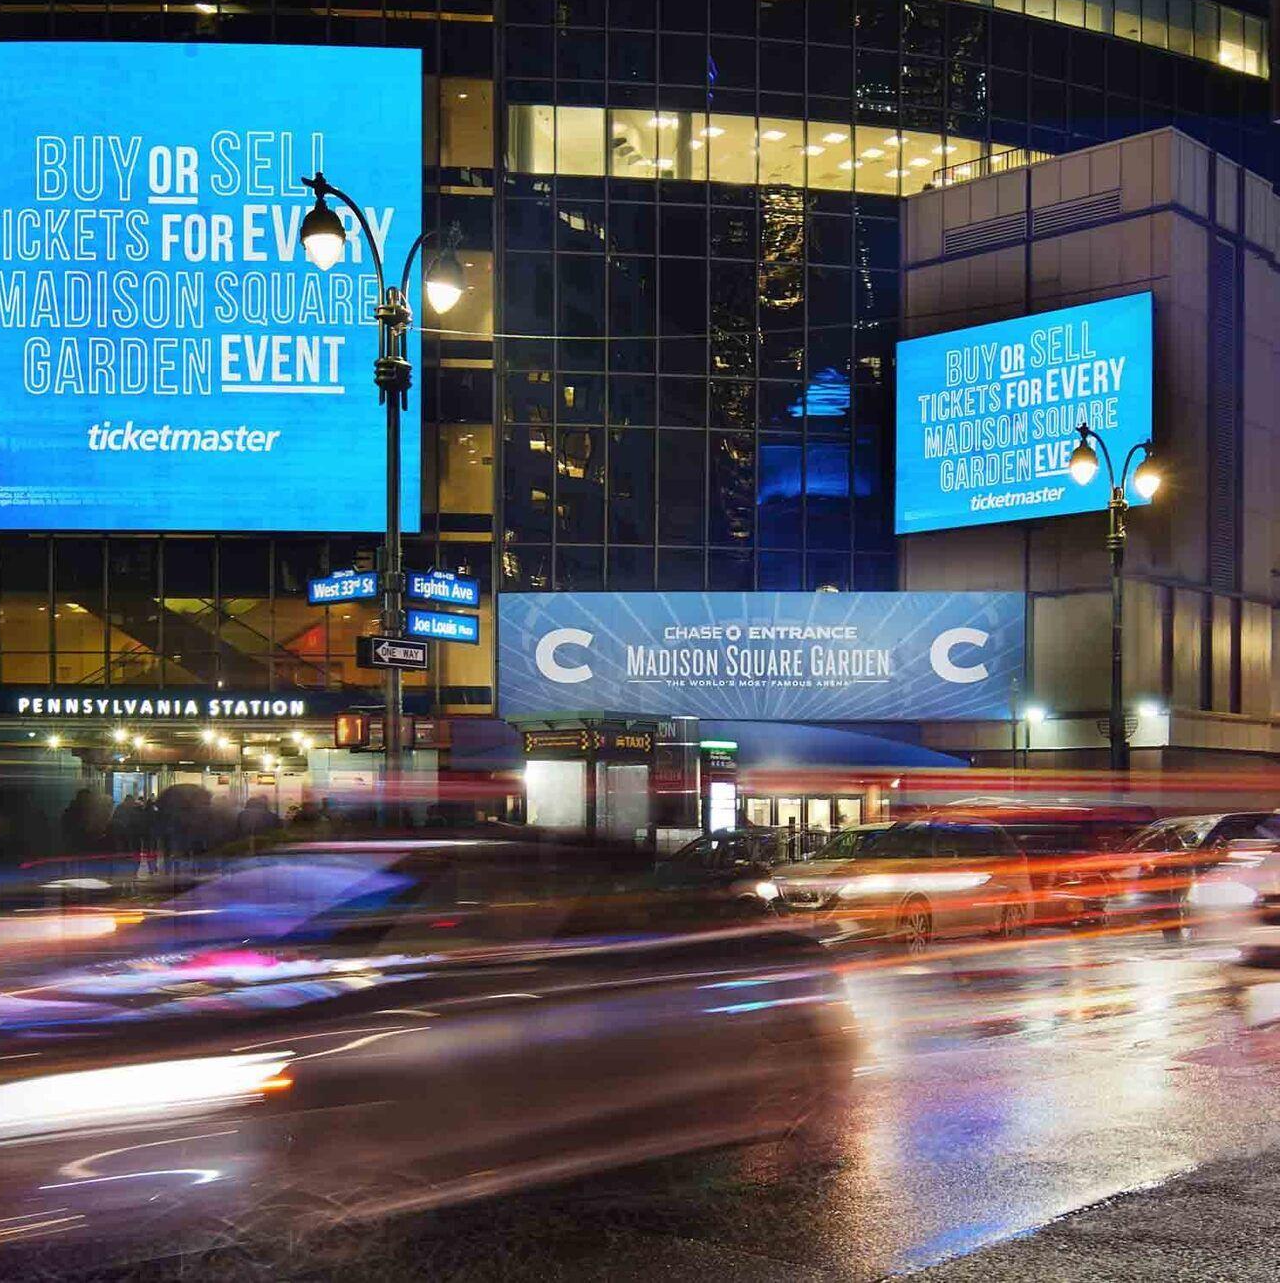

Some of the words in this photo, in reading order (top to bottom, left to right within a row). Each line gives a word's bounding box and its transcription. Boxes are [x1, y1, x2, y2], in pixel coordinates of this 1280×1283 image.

[35, 135, 142, 201] BUY
[148, 145, 199, 195] OR
[161, 213, 234, 262] FOR
[243, 204, 395, 263] EVRY
[214, 270, 379, 326] SQUARE
[23, 336, 212, 395] GARDEN
[221, 334, 346, 383] EVENT
[946, 342, 998, 387] BUY
[1000, 343, 1025, 373] OR
[1030, 321, 1096, 368] SELL
[918, 382, 1001, 424] TICKETS
[1006, 378, 1042, 410] FOR
[1046, 356, 1126, 403] EVERY
[87, 420, 281, 452] ticketmaster
[924, 412, 1028, 459] MADISON
[1033, 397, 1119, 440] SQUARE
[939, 448, 1032, 493] GARDEN
[1034, 436, 1096, 472] EVE
[969, 486, 1066, 511] ticketmaster
[313, 582, 339, 599] West
[341, 579, 361, 595] 33rd
[362, 578, 374, 593] St
[413, 578, 450, 599] Eighth
[451, 583, 474, 600] Ave
[413, 616, 430, 632] Joe
[432, 618, 457, 634] Louis
[664, 625, 723, 640] CHASE
[748, 625, 858, 640] ENTRANCE
[381, 646, 397, 657] ONE
[402, 648, 420, 660] WAY
[627, 645, 719, 677] MADISON
[726, 645, 804, 680] SQUARE
[810, 645, 890, 677] GARDEN
[666, 679, 686, 687] THE
[690, 679, 735, 687] WORLD'S
[739, 679, 767, 687] MOST
[771, 679, 812, 687] FAMOUS
[18, 697, 199, 715] PENNSYLVANIA
[209, 698, 304, 716] STATION
[624, 736, 645, 748] TAXI
